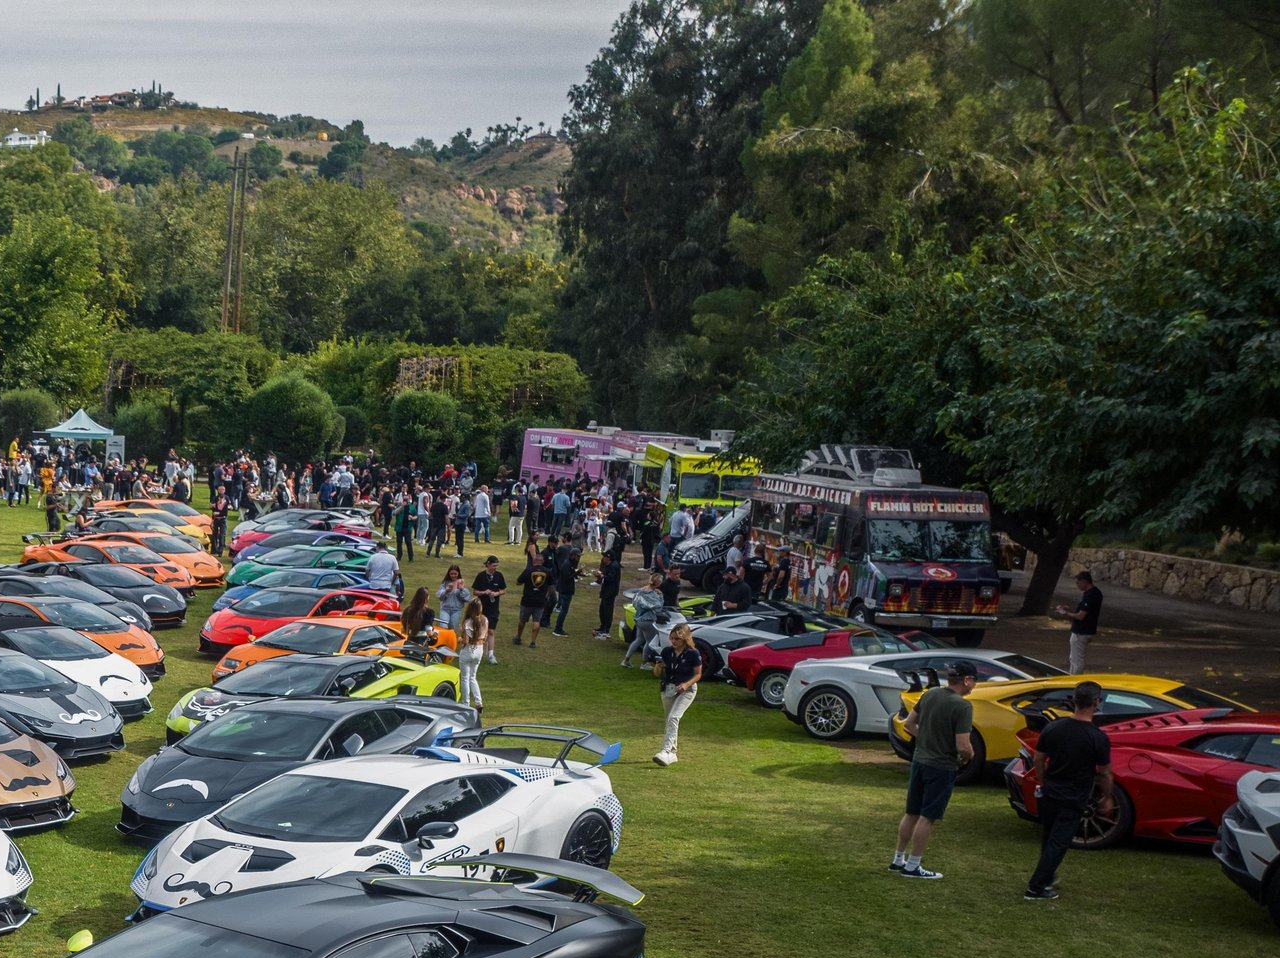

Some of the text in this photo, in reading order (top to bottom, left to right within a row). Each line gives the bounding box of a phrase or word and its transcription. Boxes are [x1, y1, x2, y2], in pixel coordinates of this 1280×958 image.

[812, 487, 852, 505] CHICKEN
[870, 501, 984, 513] FLAMIN HOT CHICKEN
